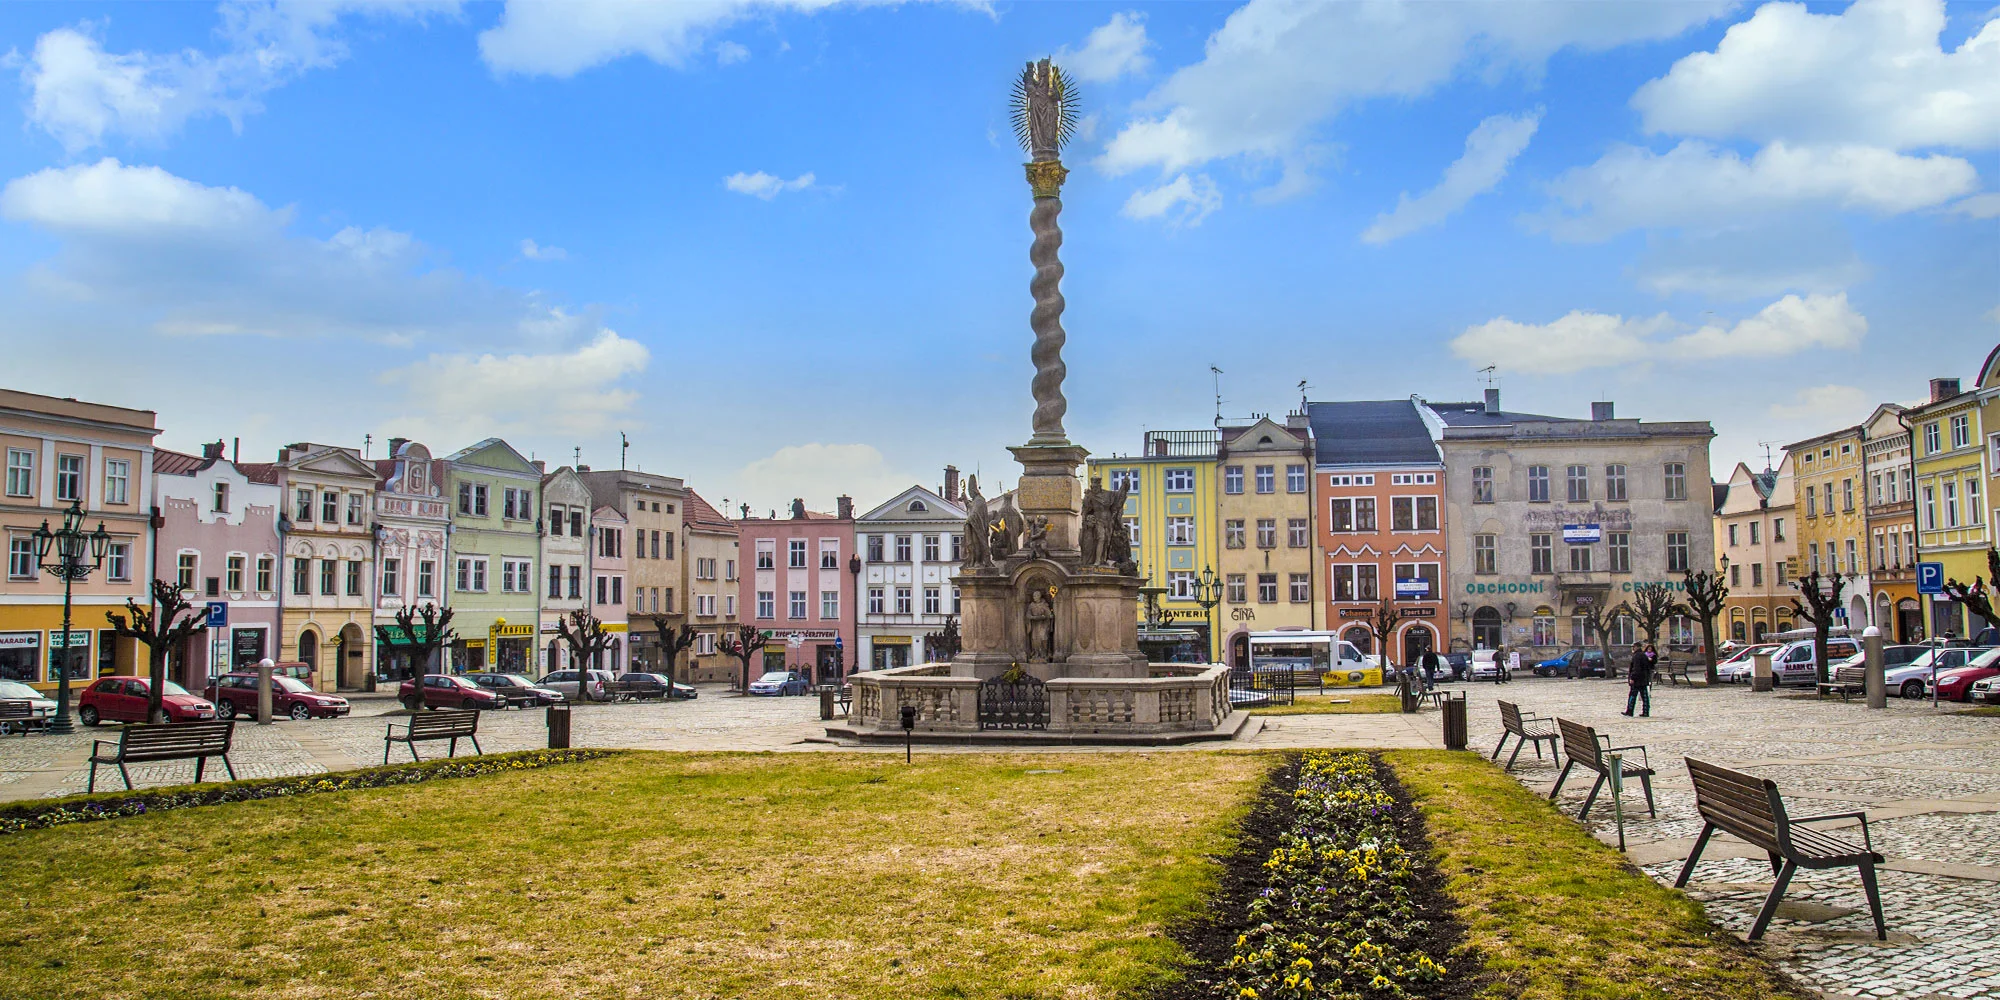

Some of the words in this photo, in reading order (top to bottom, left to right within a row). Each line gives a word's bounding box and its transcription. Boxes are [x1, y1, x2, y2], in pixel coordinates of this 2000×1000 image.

[1922, 566, 1937, 585] P
[1466, 579, 1545, 595] OBCHODNÍ
[1622, 581, 1700, 593] CENTRU
[211, 604, 223, 620] P
